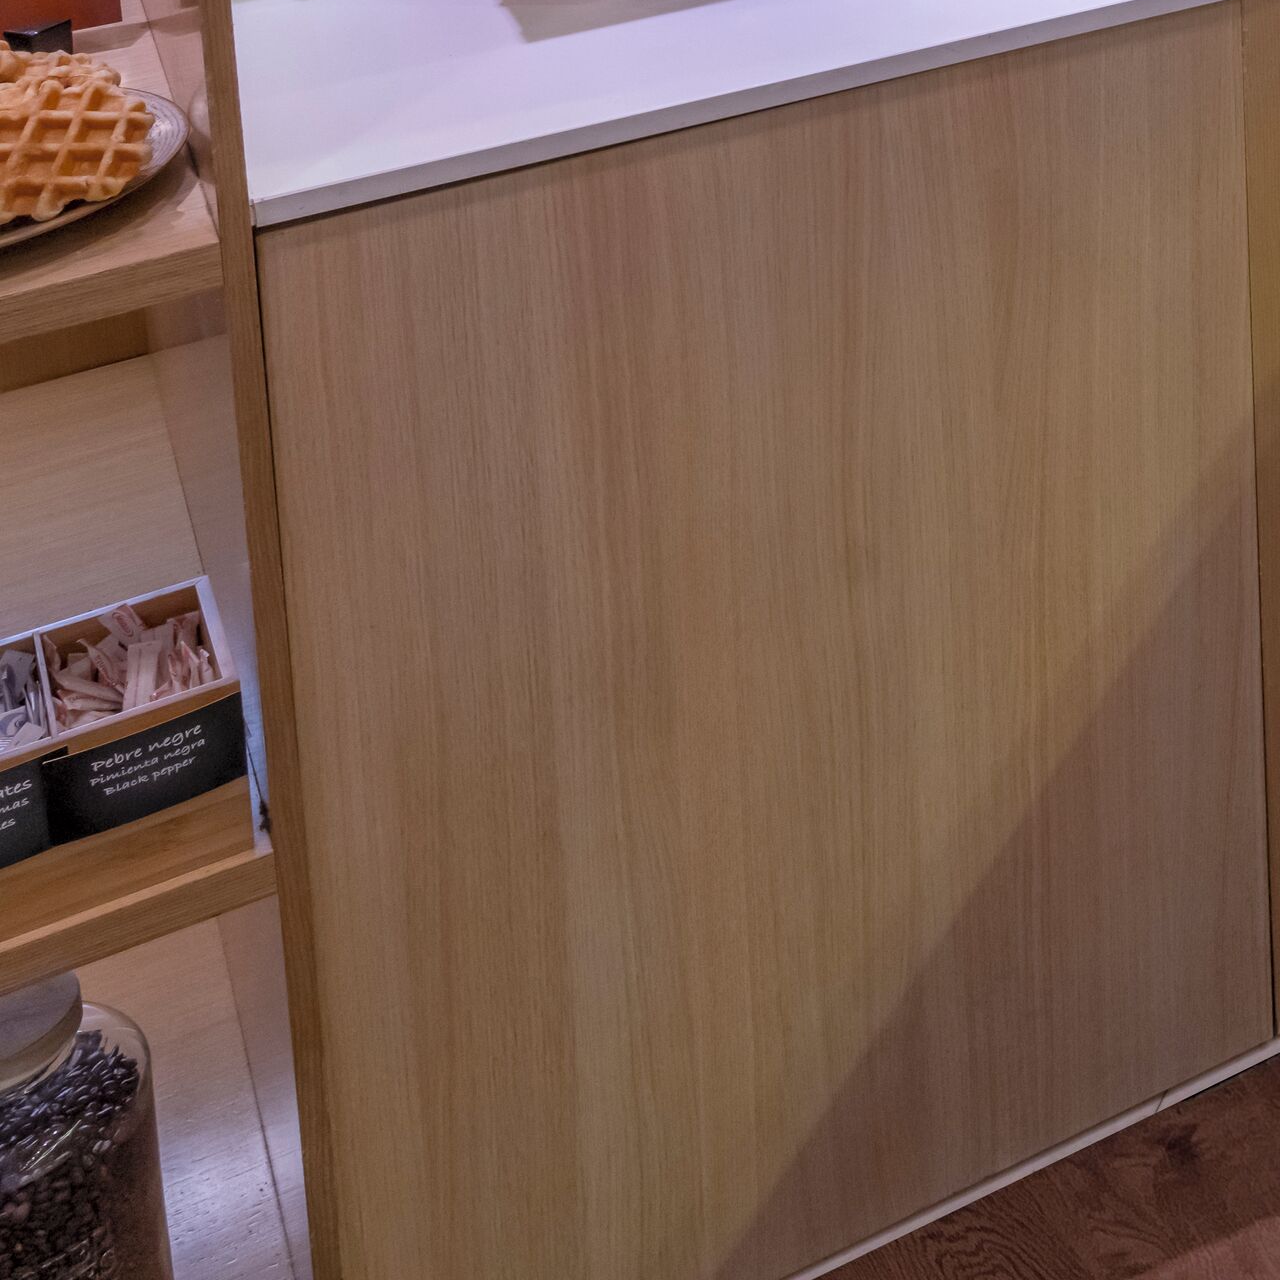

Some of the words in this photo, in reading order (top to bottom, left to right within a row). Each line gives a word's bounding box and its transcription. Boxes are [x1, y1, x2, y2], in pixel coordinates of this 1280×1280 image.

[89, 756, 159, 787] Pimienta
[163, 737, 206, 761] negra
[90, 746, 144, 772] Pebre
[148, 724, 203, 752] negre
[103, 774, 150, 796] Black
[152, 755, 197, 782] pepper
